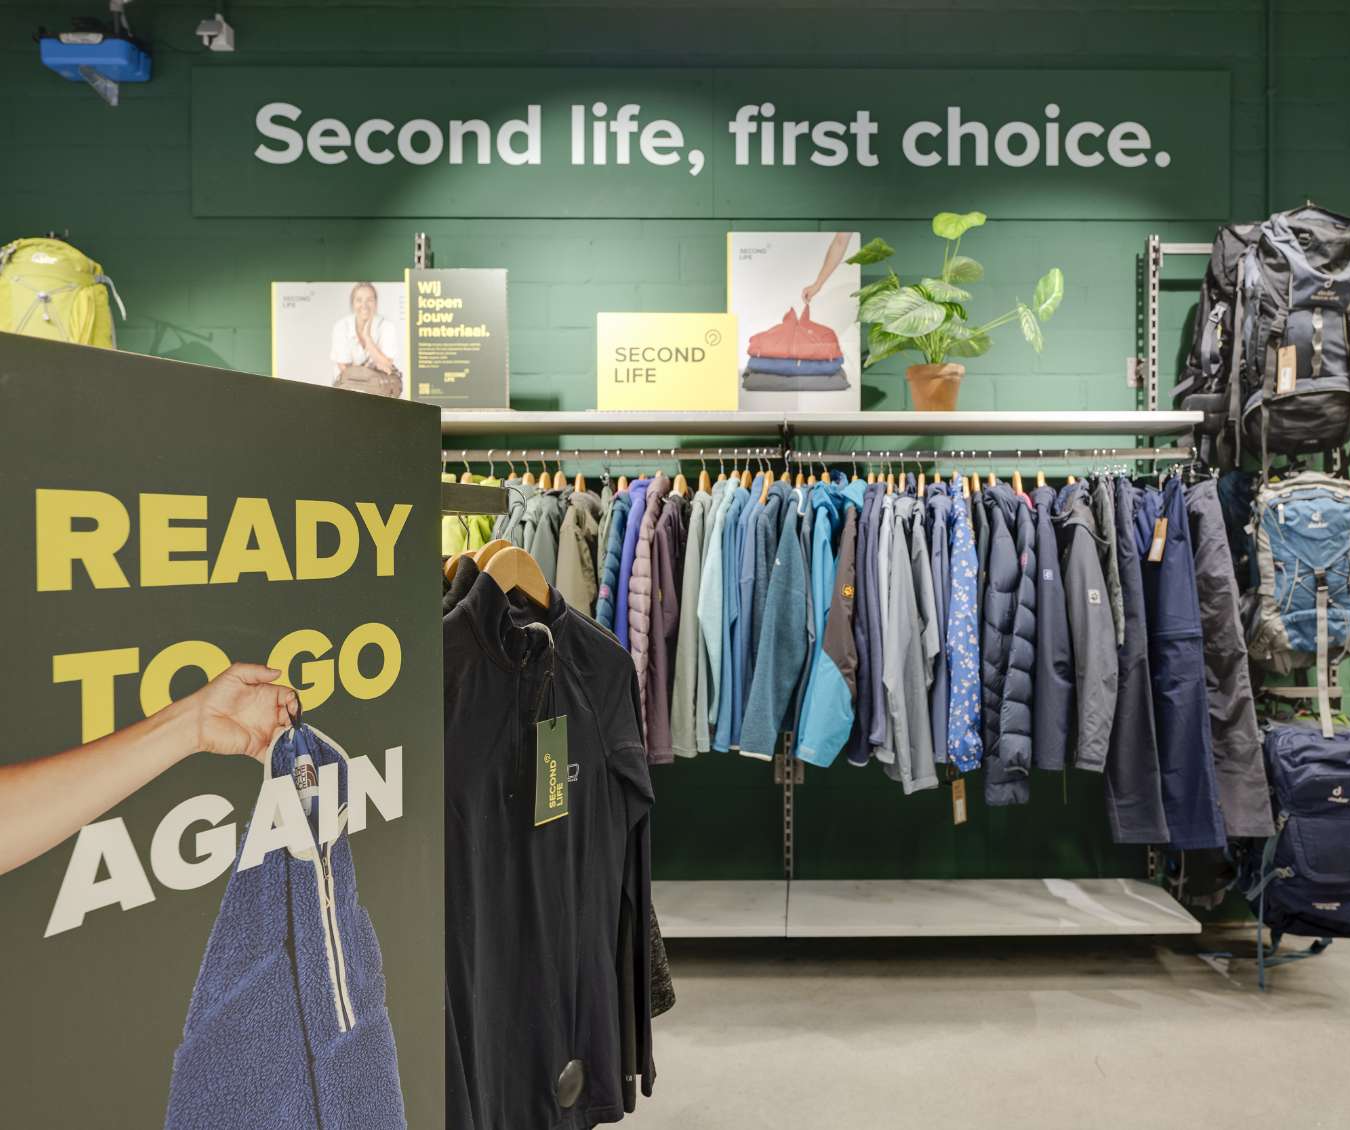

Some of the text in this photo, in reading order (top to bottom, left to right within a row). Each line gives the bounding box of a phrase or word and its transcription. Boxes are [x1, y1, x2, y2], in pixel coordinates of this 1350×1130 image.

[254, 101, 1171, 176] Second life, first choice.
[417, 280, 441, 296] Wij
[418, 295, 463, 311] kopen
[416, 310, 454, 325] jouw
[418, 324, 490, 337] materiaal.
[614, 346, 706, 363] SECOND
[614, 367, 657, 383] LIFE
[36, 488, 413, 592] READY
[266, 622, 402, 714] GO
[549, 759, 557, 808] SECOND
[556, 782, 564, 807] LIFE
[44, 745, 403, 938] AGAIN
